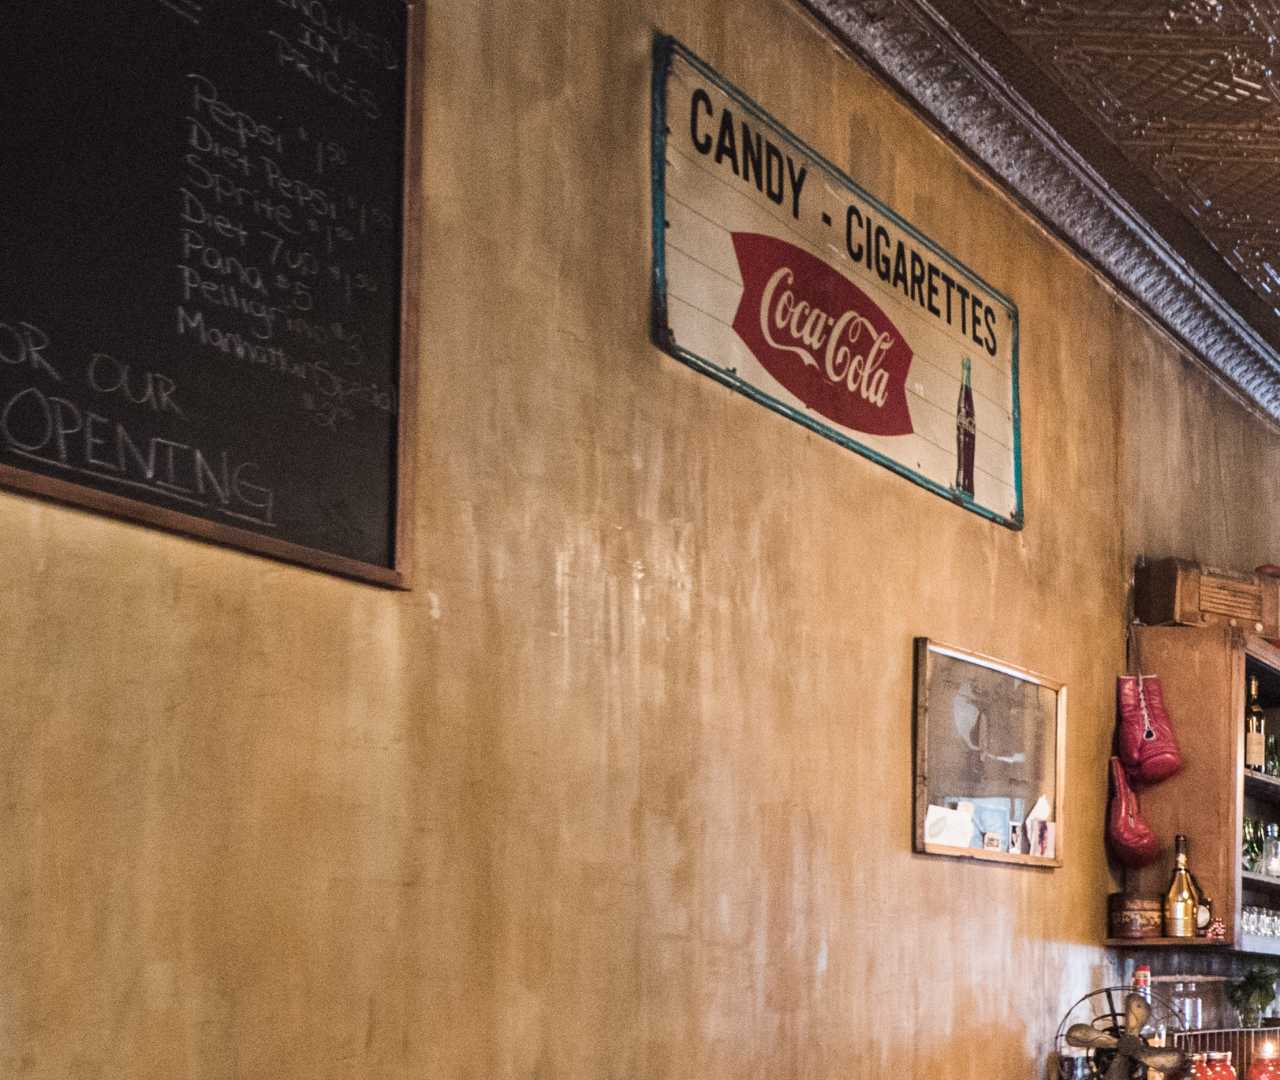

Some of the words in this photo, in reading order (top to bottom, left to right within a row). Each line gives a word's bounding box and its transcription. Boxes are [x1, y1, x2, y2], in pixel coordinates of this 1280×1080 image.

[186, 73, 284, 154] Pepsi
[184, 153, 301, 234] Sprite
[260, 154, 337, 220] Pepsi
[690, 87, 807, 219] CANDY
[846, 204, 998, 357] CIGARETTES
[760, 267, 894, 408] Coca-Cola
[88, 353, 189, 421] OUR
[2, 387, 274, 523] OPENING
